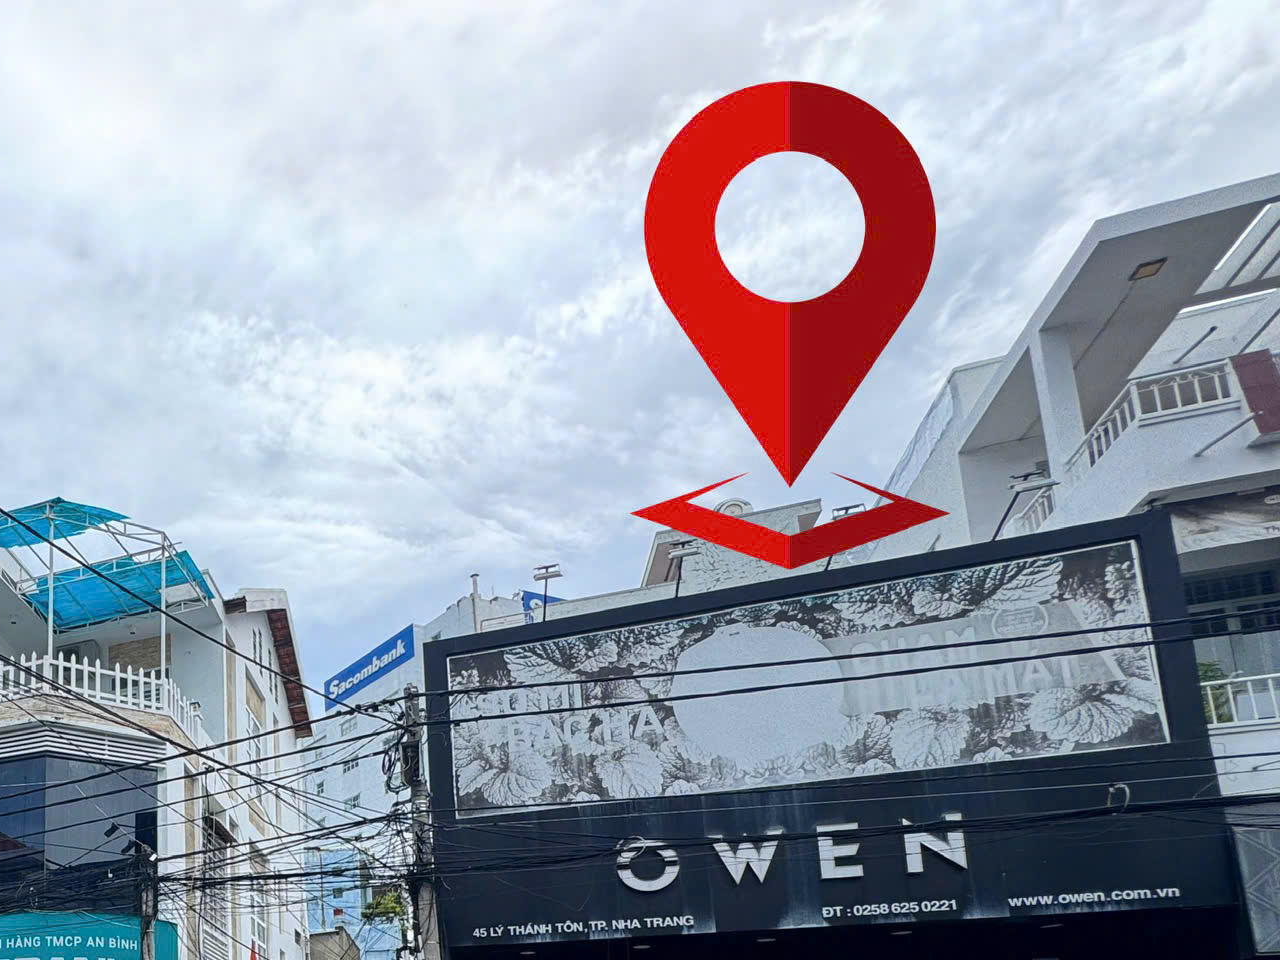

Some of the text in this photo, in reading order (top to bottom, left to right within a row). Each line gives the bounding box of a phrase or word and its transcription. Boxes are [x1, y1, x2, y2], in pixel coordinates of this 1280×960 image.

[328, 639, 407, 699] Sacombank
[616, 813, 968, 892] OWEN
[1008, 886, 1181, 907] www.owen.com.vn
[822, 905, 844, 918] ĐT
[853, 903, 890, 916] 0258
[891, 902, 920, 914] 625
[921, 899, 958, 912] 0221
[472, 927, 488, 938] 45
[489, 924, 504, 937] LÝ
[507, 922, 553, 936] THÁNH
[588, 920, 609, 931] TP.
[611, 919, 642, 931] NHA
[643, 915, 695, 928] TRANG
[6, 933, 41, 949] HÀNG
[44, 936, 83, 948] TMCP
[86, 936, 105, 948] AN
[108, 934, 139, 951] BÌNH
